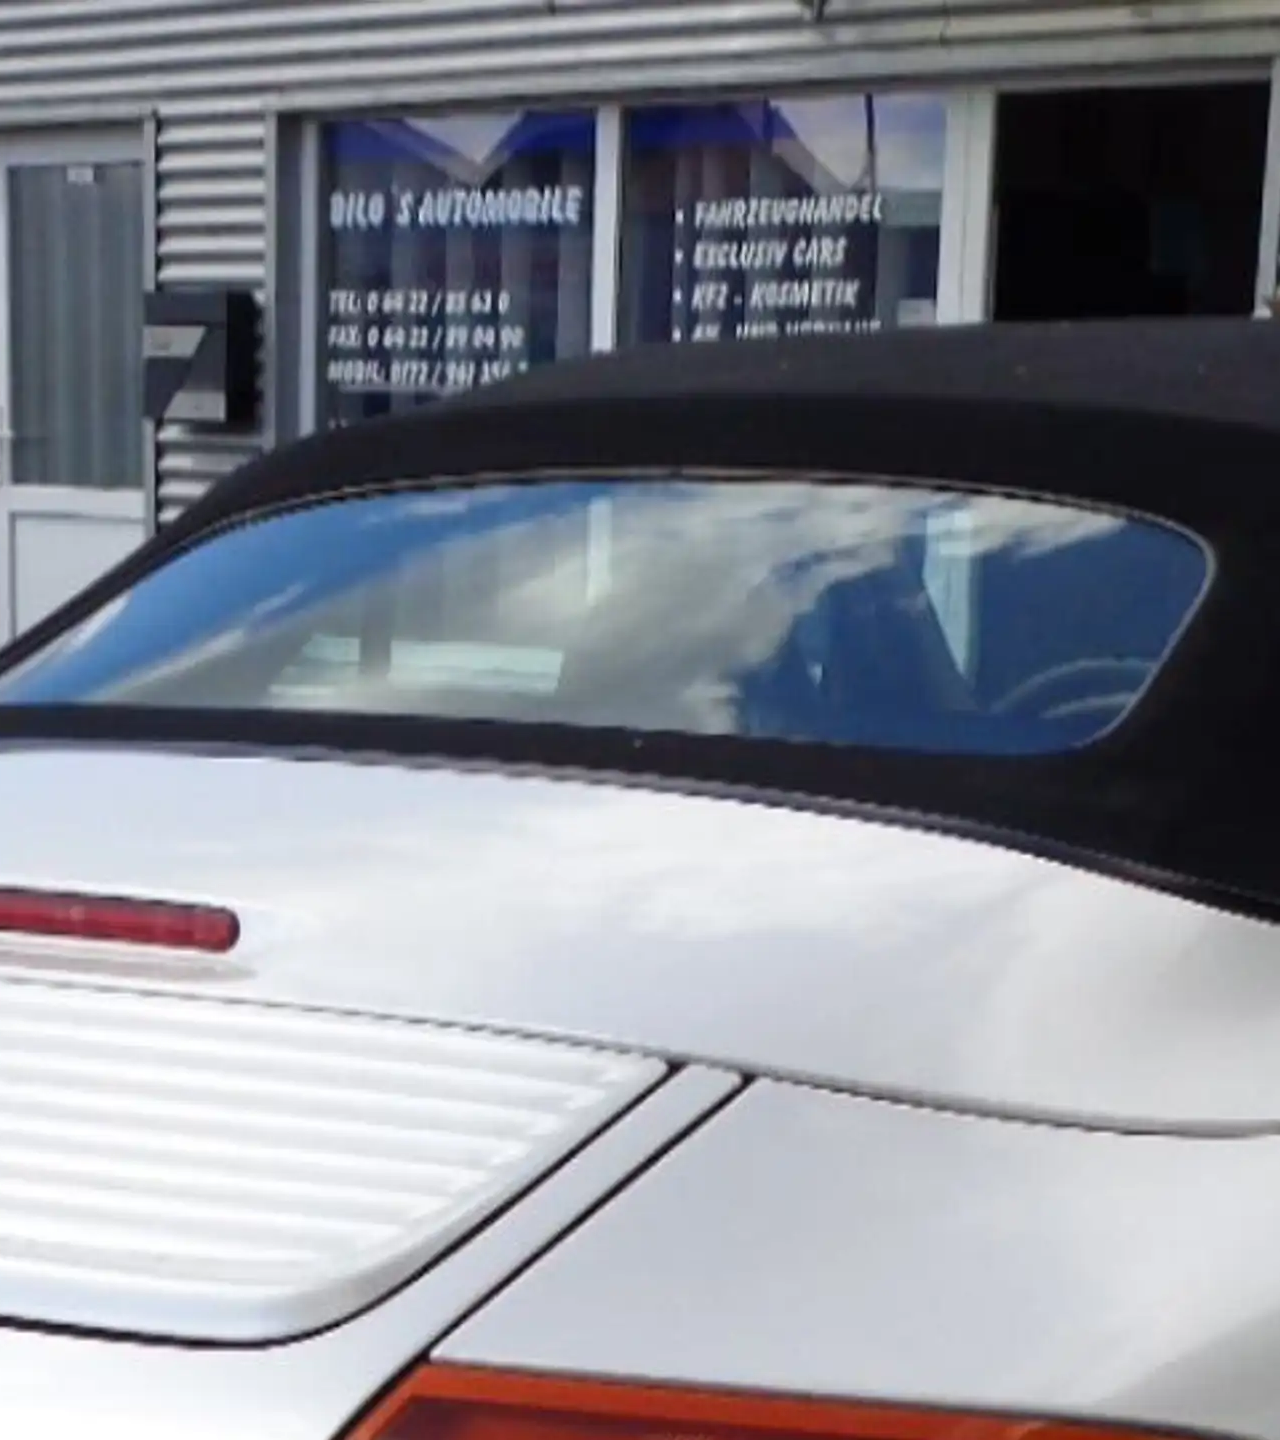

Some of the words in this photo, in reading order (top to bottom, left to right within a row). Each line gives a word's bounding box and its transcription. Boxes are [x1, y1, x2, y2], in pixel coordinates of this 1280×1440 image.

[418, 184, 584, 228] AUTOMOBILE
[694, 193, 882, 230] FAHRZEUGHANDEL
[792, 236, 847, 266] CARS
[691, 281, 729, 311] KFZ
[750, 279, 861, 310] KOSMETIK
